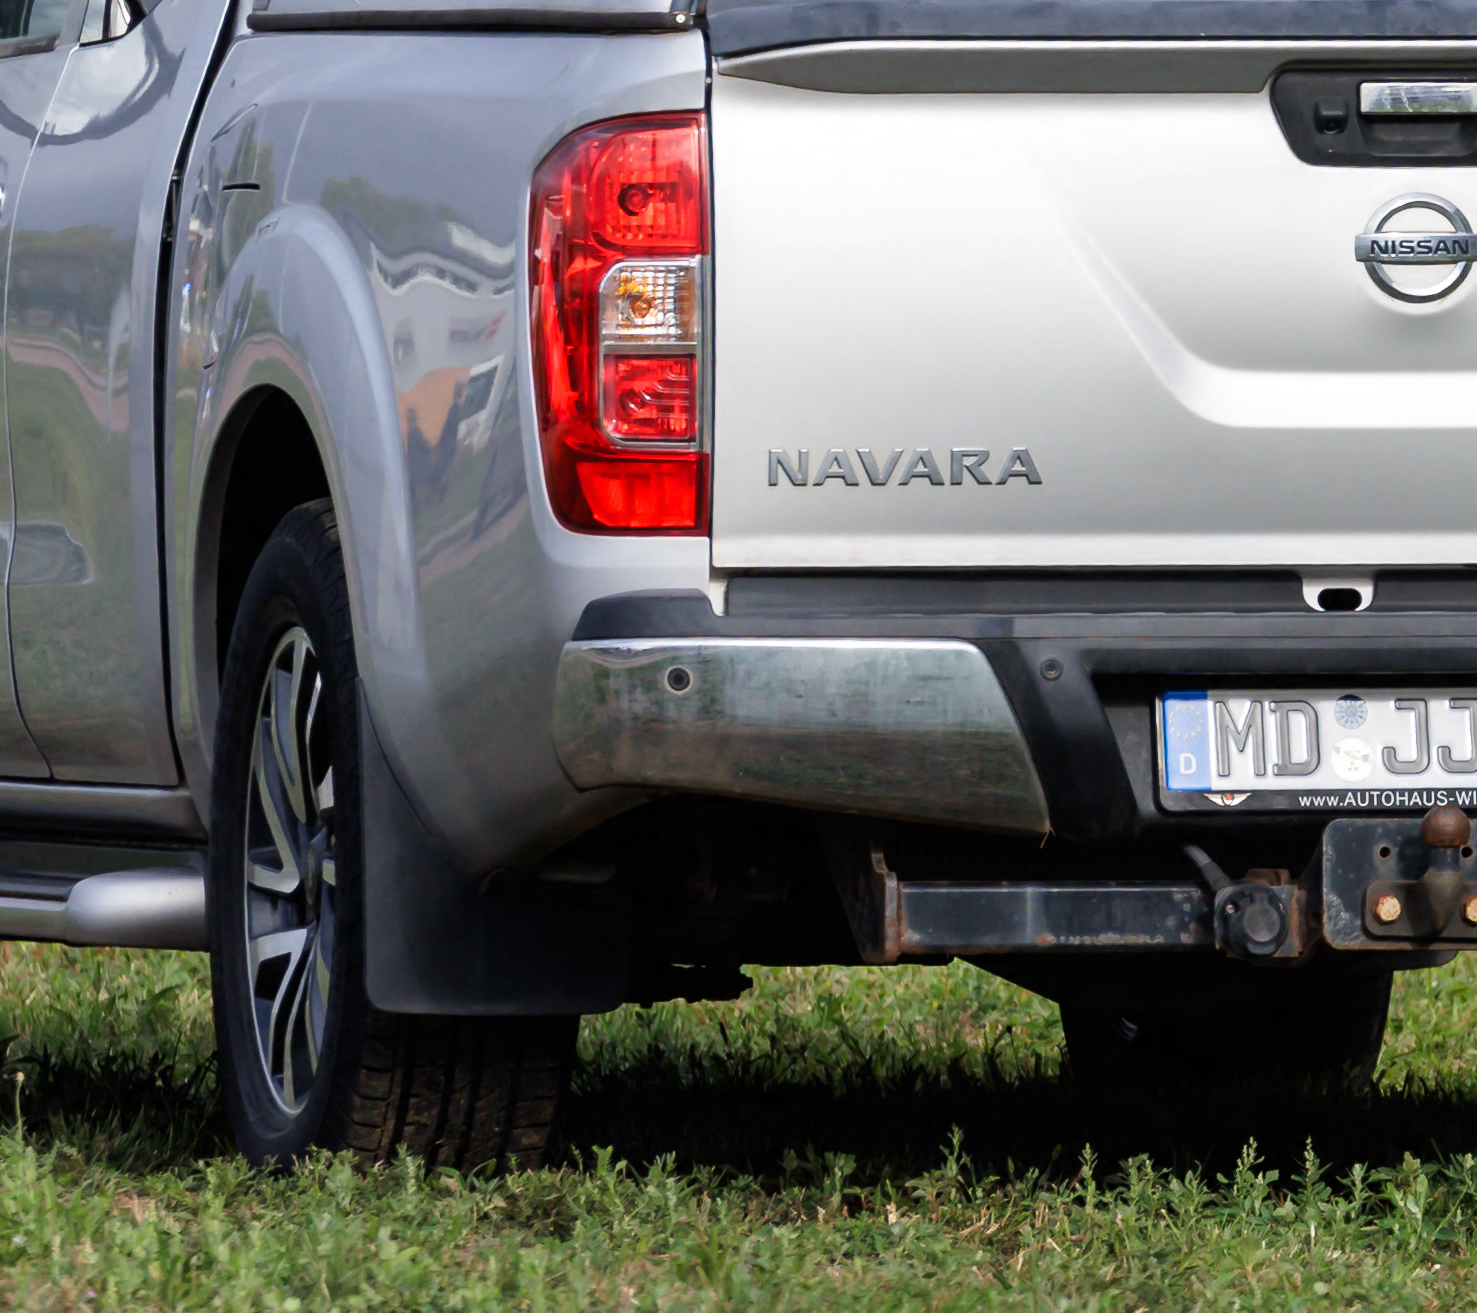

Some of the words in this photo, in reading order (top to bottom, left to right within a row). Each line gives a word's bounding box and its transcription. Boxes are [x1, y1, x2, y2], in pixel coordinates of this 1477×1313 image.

[1370, 239, 1469, 255] NISSAN
[767, 446, 1043, 488] NAVARA
[1214, 699, 1320, 777] MD
[1179, 753, 1198, 775] D
